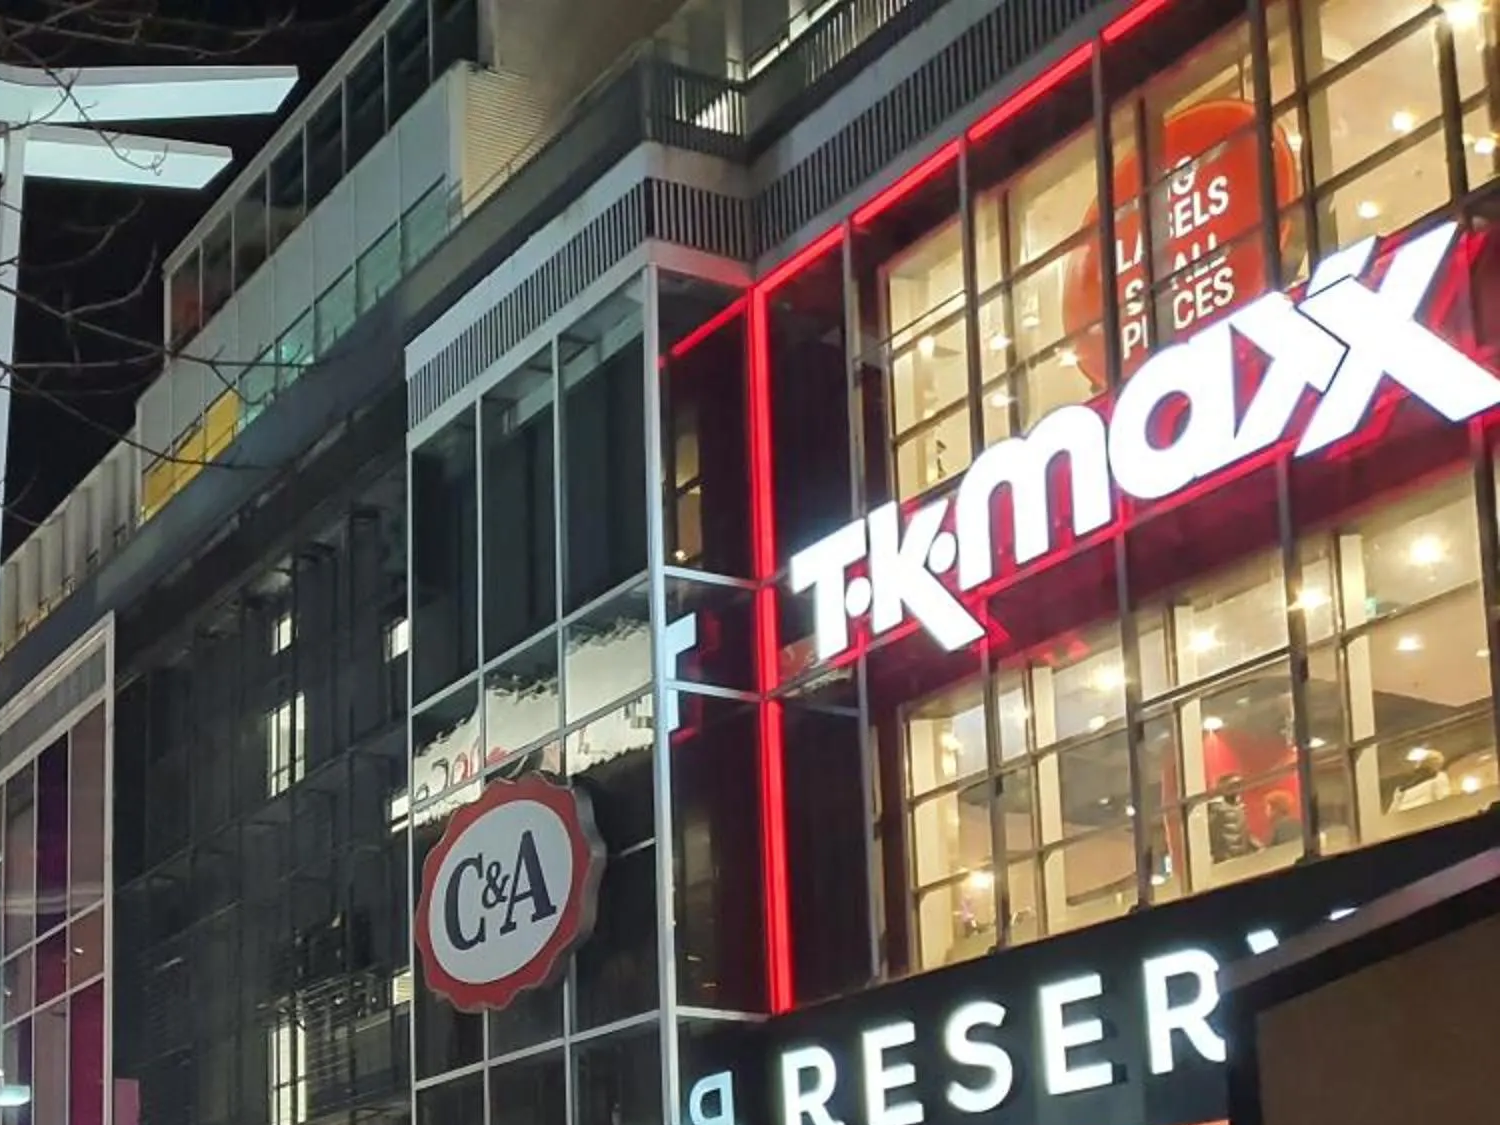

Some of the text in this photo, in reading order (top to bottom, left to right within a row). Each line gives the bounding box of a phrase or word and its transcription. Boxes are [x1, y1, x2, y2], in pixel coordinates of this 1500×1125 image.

[1115, 175, 1230, 276] LELS
[1125, 232, 1228, 316] SALL
[1123, 266, 1235, 359] PCES
[444, 829, 557, 951] C&A
